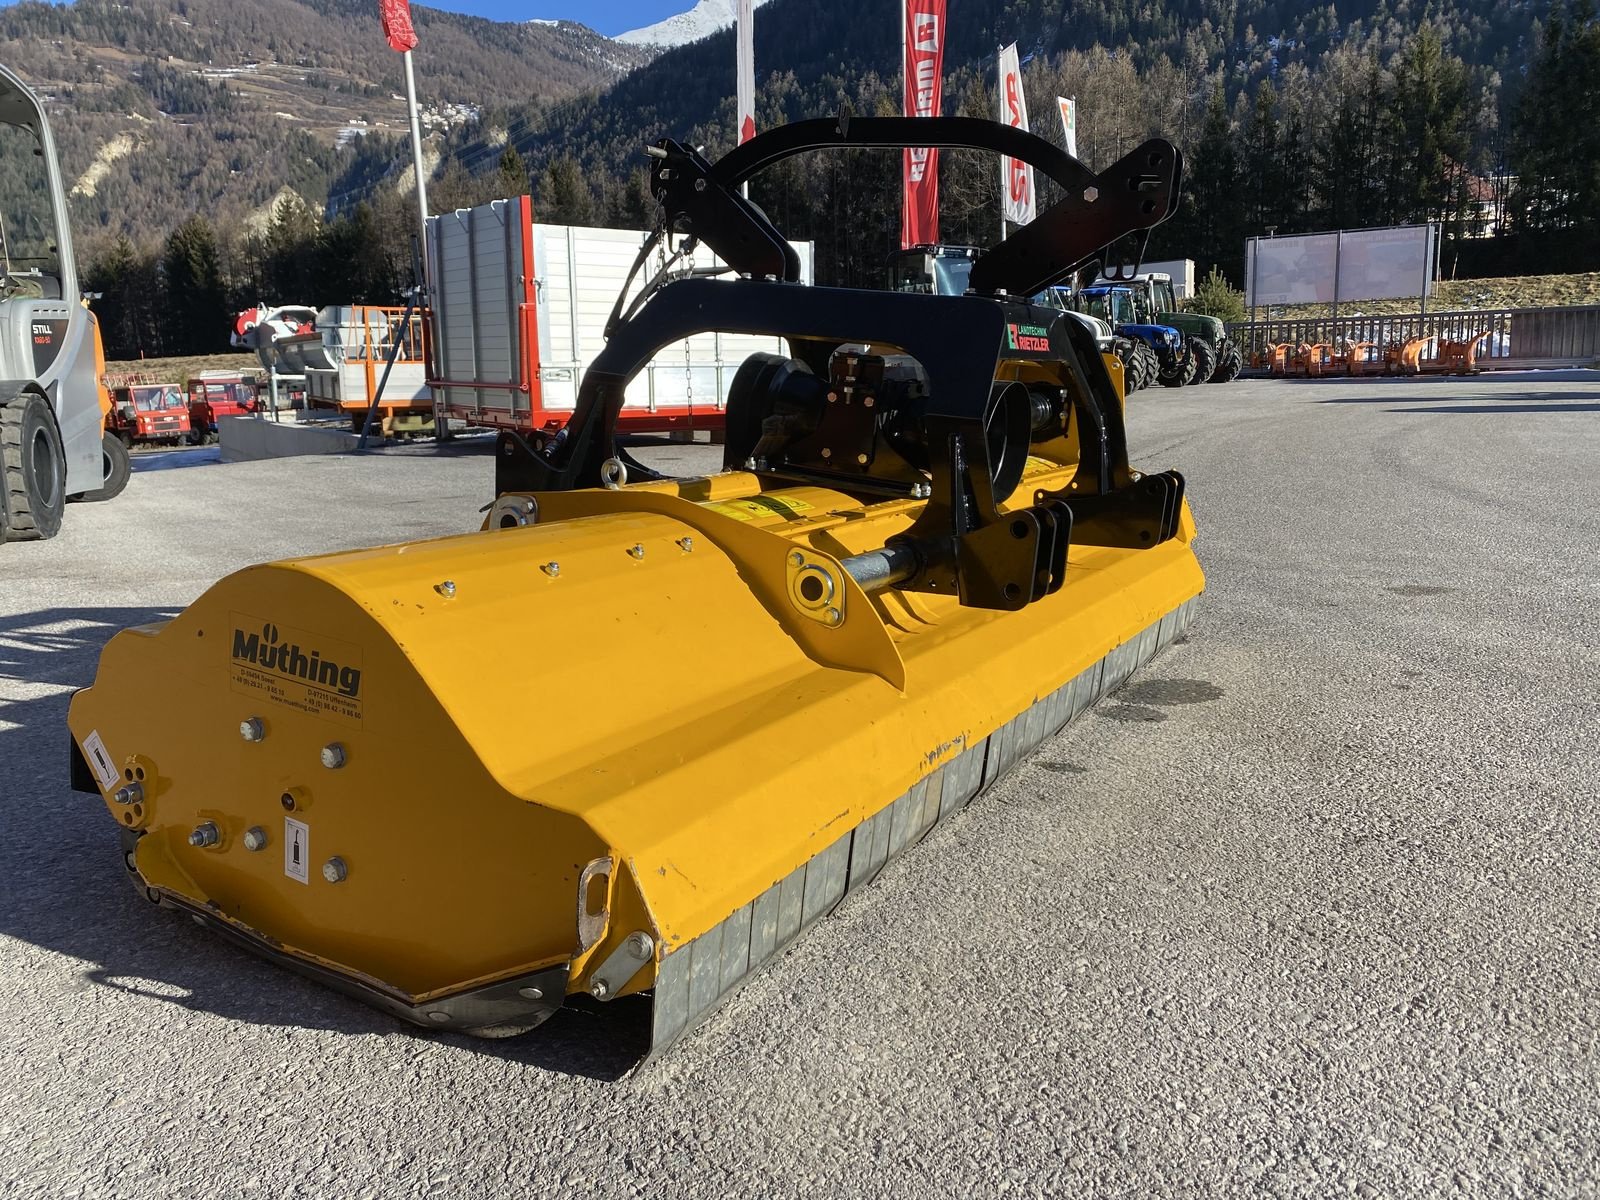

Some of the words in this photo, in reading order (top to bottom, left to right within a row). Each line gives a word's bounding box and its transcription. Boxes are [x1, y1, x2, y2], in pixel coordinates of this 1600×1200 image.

[32, 324, 53, 334] STILL
[1018, 324, 1048, 337] LANDTECHNIK
[1018, 336, 1050, 352] RIETZLER
[232, 623, 361, 697] Müthing
